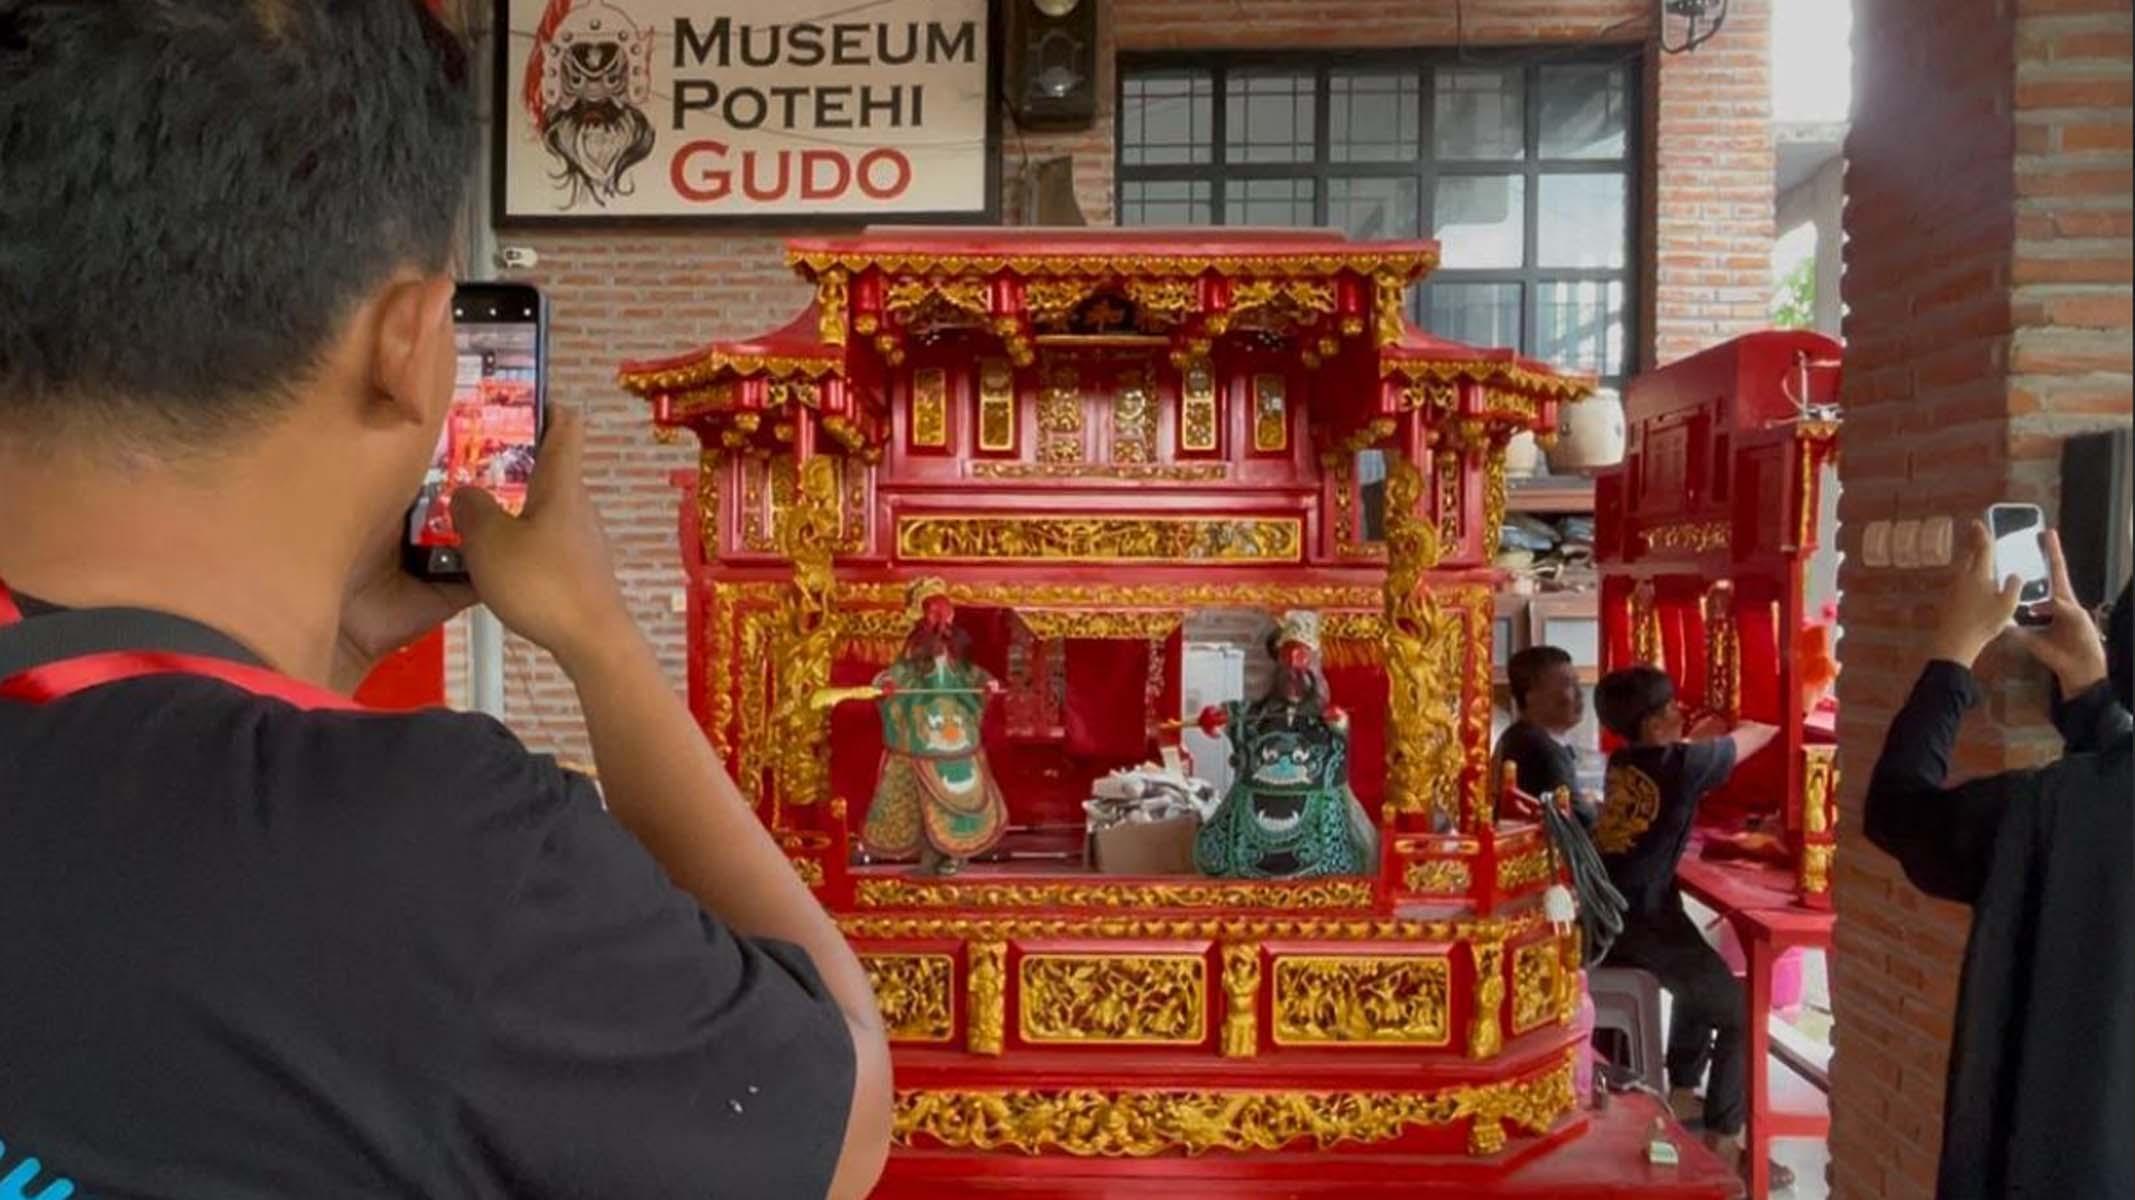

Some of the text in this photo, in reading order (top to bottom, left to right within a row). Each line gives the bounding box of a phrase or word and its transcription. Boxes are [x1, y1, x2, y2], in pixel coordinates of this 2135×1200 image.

[673, 17, 976, 67] MUSEUM
[672, 79, 924, 130] POTEHI
[670, 139, 911, 203] GUDO
